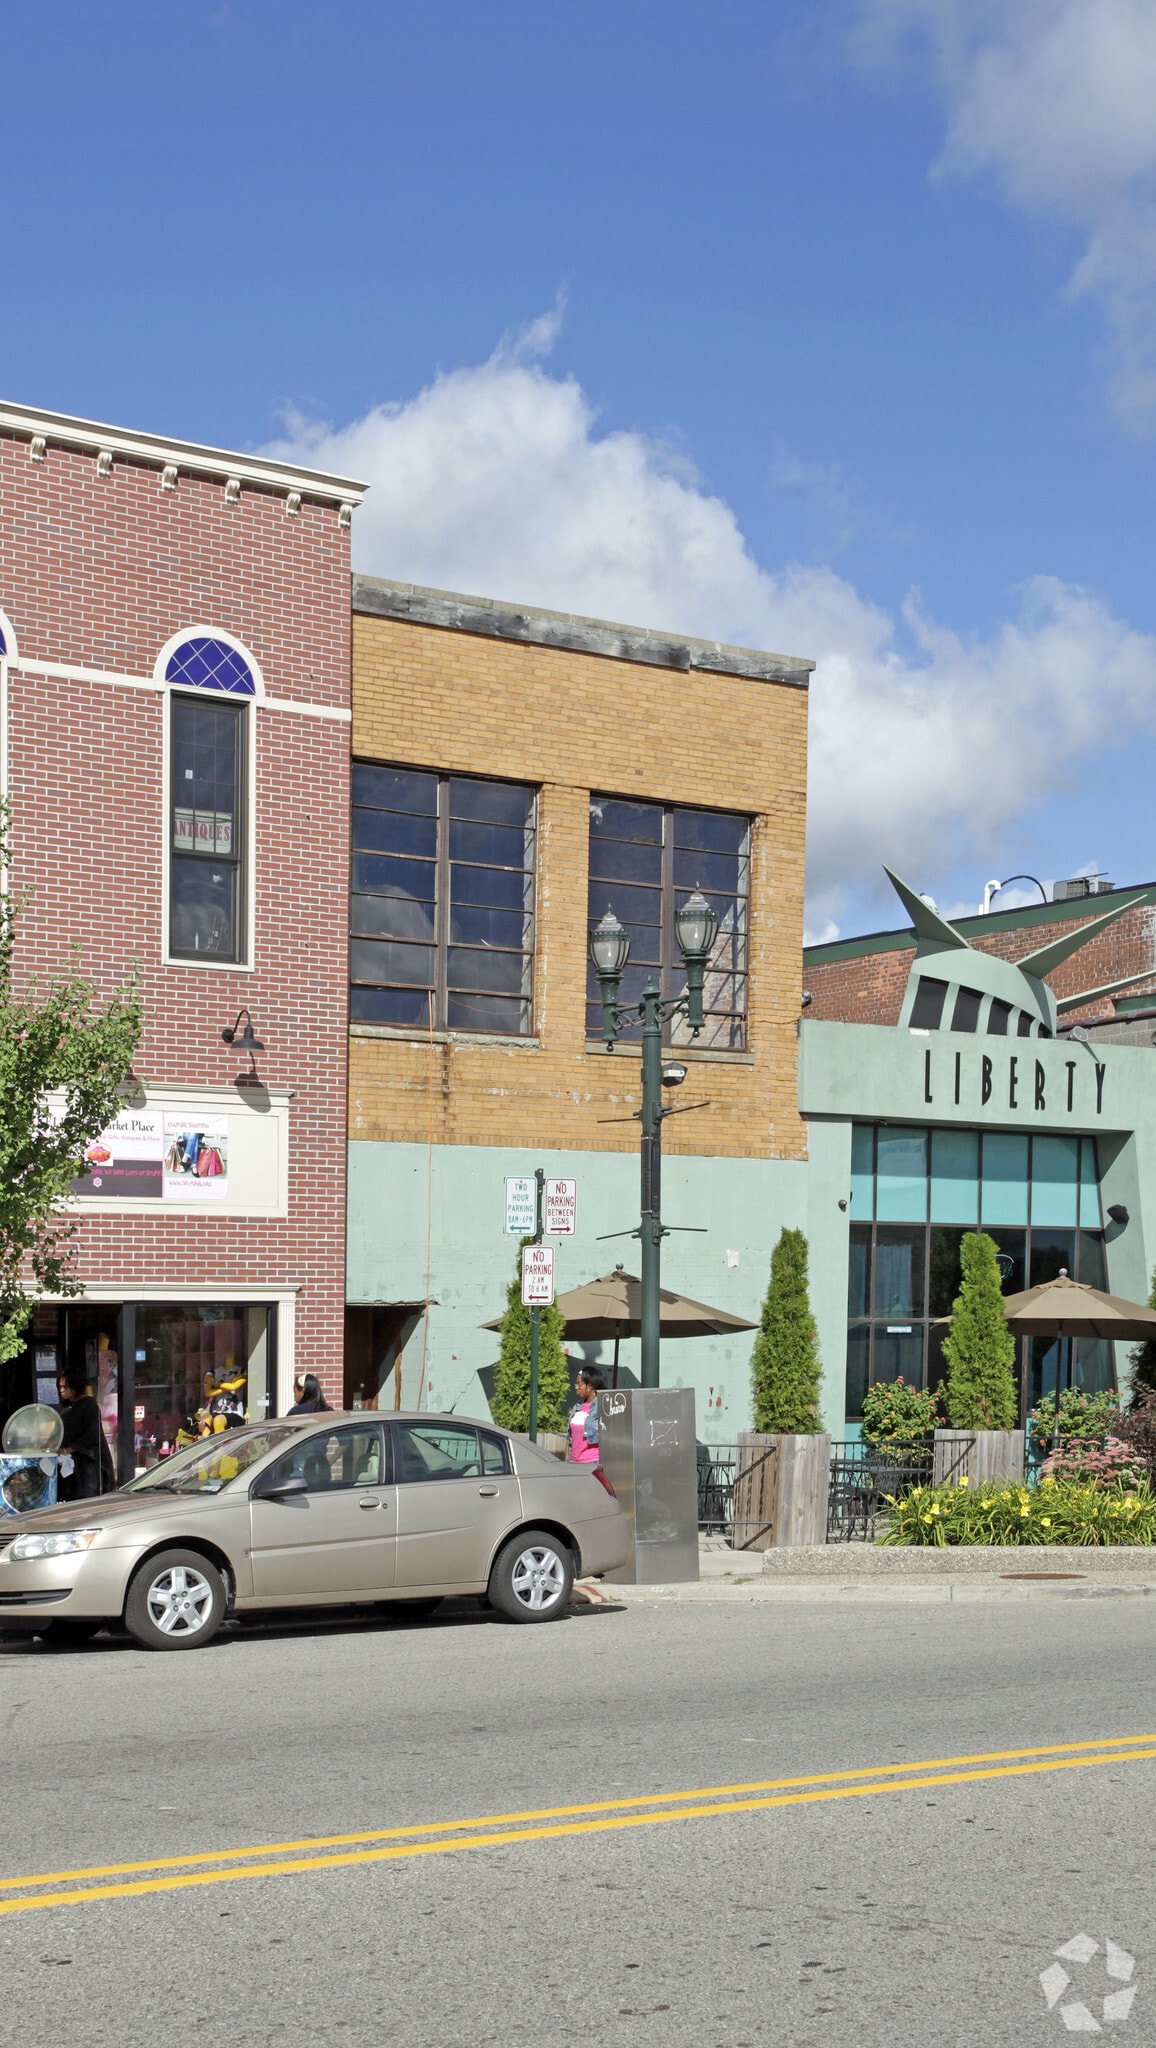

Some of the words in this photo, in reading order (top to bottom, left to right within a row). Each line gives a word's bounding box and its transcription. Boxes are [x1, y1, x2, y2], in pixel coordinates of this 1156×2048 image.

[174, 820, 230, 842] ANTIQUES
[924, 1049, 1106, 1114] LIBERTY
[104, 1119, 129, 1132] arket
[131, 1120, 155, 1132] Place
[515, 1183, 528, 1191] TWO
[555, 1183, 567, 1194] NO
[512, 1194, 529, 1202] HOUR
[547, 1196, 574, 1207] PARKING
[508, 1204, 533, 1212] PARKING
[547, 1209, 574, 1217] BETWEEN
[552, 1217, 569, 1225] SIGNS
[533, 1251, 544, 1263] NO
[525, 1264, 552, 1275] PARKING
[537, 1276, 545, 1284] AM
